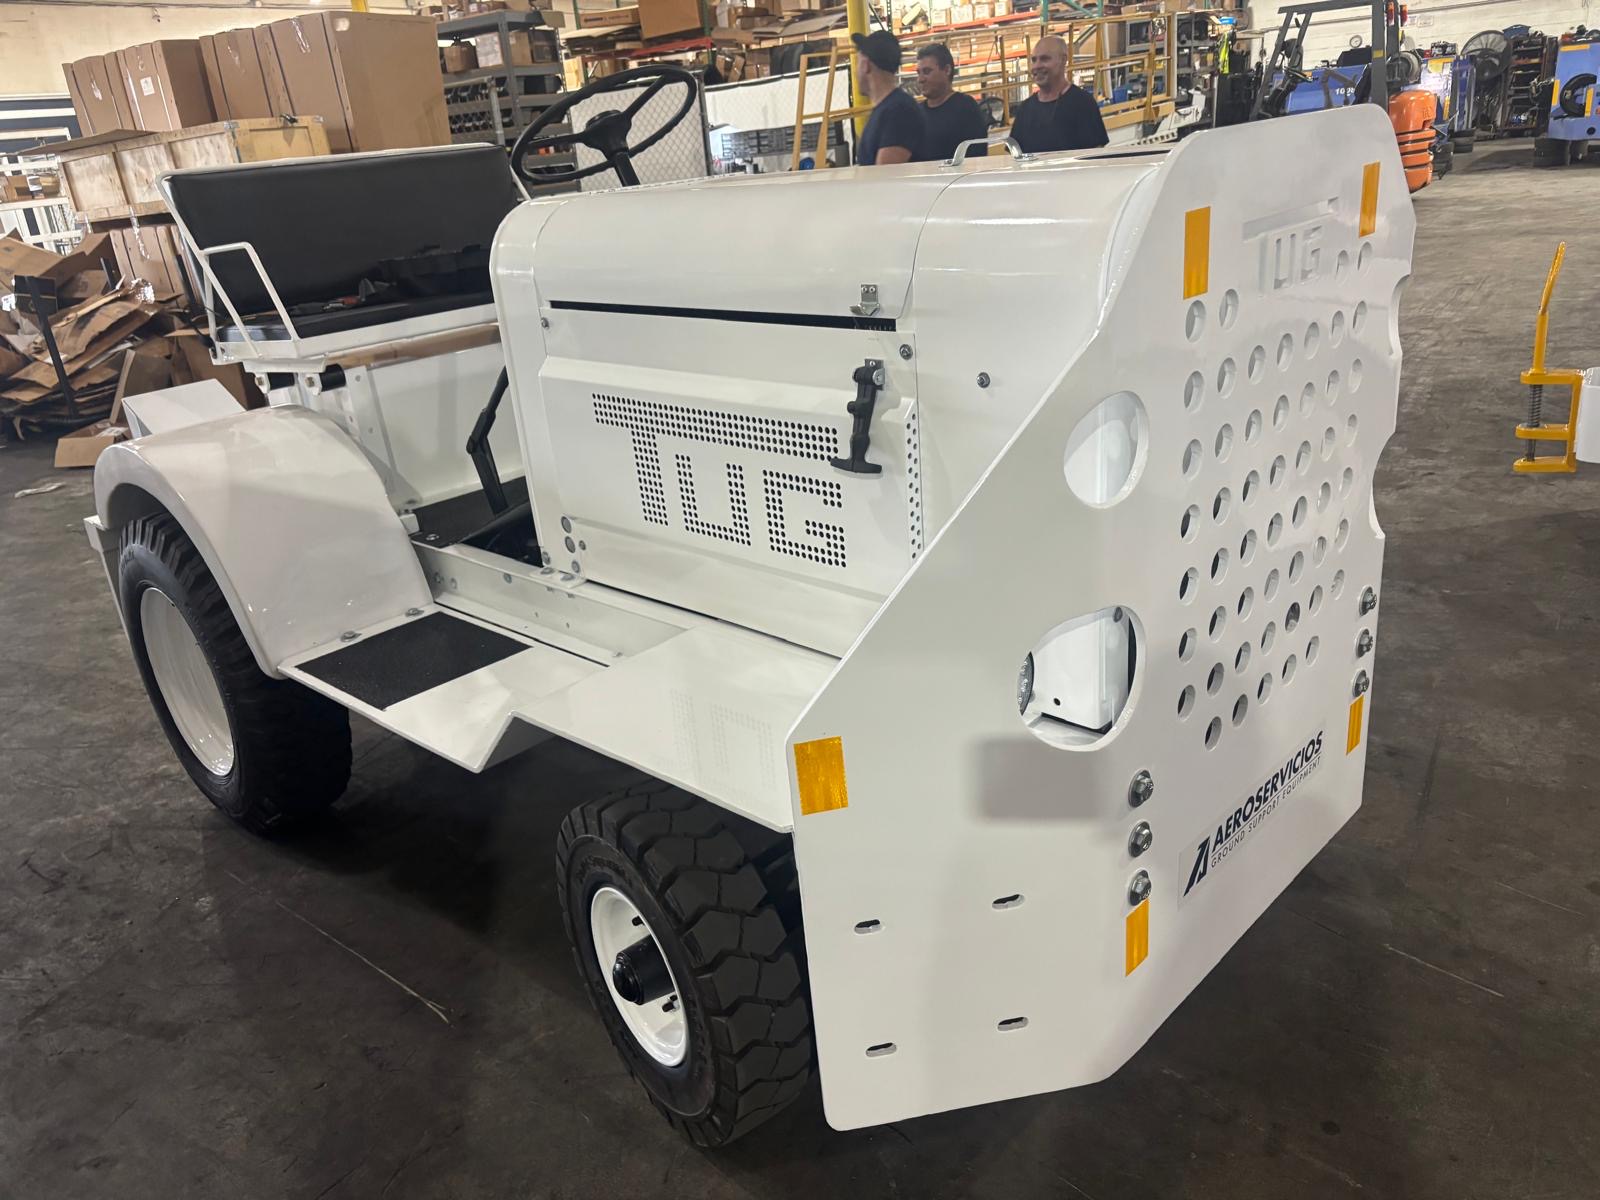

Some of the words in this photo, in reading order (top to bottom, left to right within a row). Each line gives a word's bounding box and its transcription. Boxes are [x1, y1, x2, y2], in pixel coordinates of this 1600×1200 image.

[1242, 197, 1339, 297] TUG
[591, 392, 846, 568] TUG
[1211, 830, 1245, 868] GROUND
[1248, 796, 1280, 833] SUPPORT
[1282, 757, 1321, 799] EQUIPMENT
[1212, 730, 1323, 852] AEROSERVICIOS
